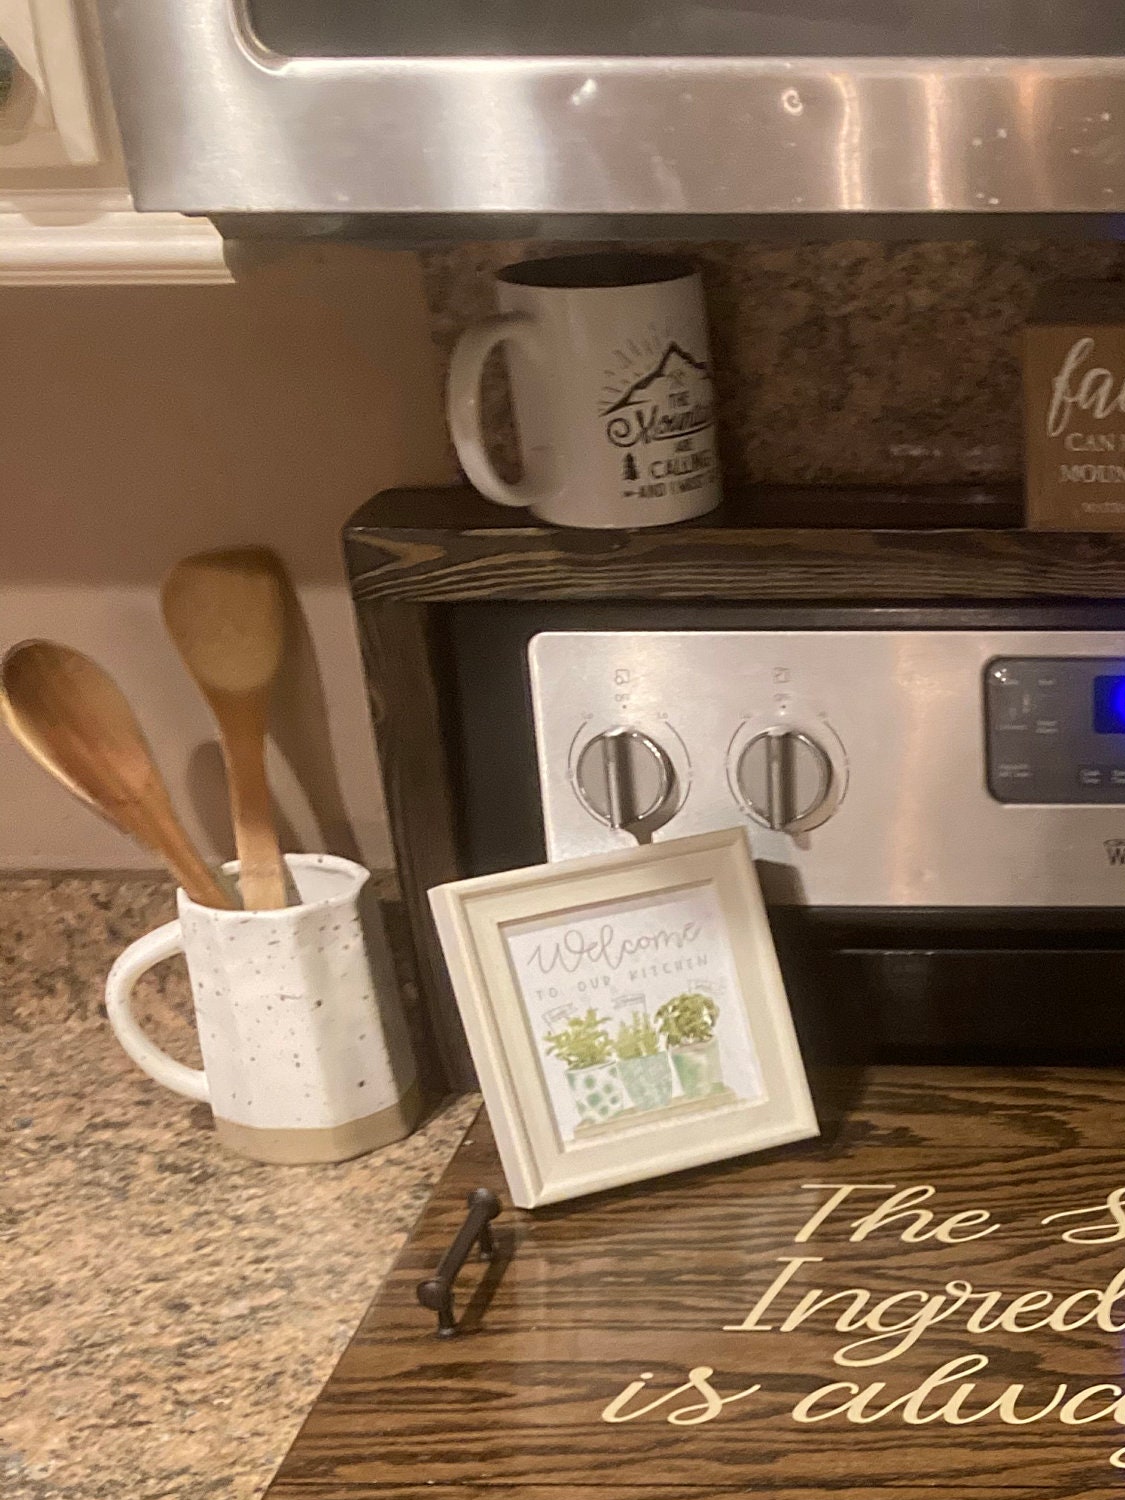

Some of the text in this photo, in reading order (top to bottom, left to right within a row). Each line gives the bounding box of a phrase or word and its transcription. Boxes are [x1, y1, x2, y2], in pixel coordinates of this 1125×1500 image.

[1064, 432, 1115, 452] CAN
[527, 923, 702, 974] Welcome
[536, 954, 708, 1001] TO OUR KITCHEN
[794, 1184, 1000, 1243] The
[601, 1366, 762, 1426] is
